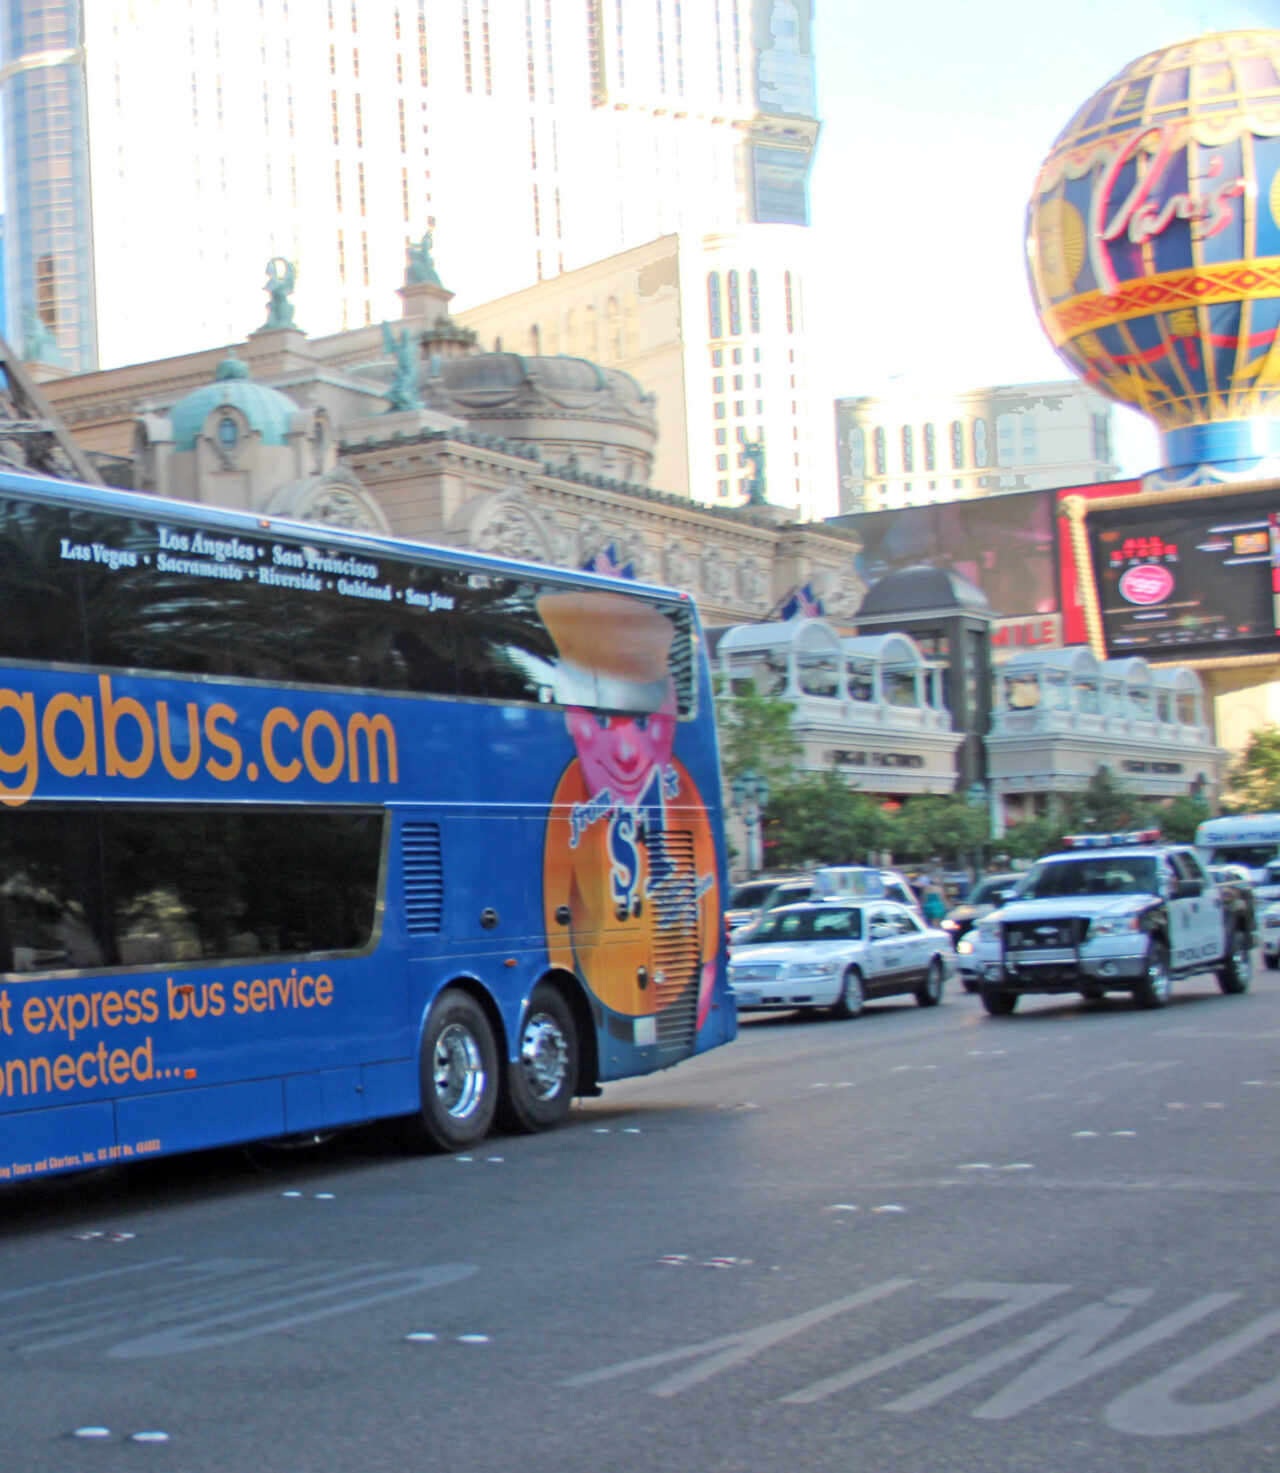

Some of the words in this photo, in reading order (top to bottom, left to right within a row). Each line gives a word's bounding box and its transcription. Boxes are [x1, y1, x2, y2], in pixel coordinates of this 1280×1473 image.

[1089, 123, 1256, 296] Paris
[61, 538, 92, 561] Las
[92, 543, 138, 570] Vegas
[157, 553, 242, 581] Sacramento
[259, 566, 322, 592] Riverside
[337, 578, 392, 602] Oakland
[405, 588, 429, 607] San
[158, 529, 190, 550] Los
[191, 533, 255, 562] Angeles
[272, 545, 304, 568] San
[305, 548, 378, 580] Francisco
[23, 987, 159, 1040] express
[167, 977, 225, 1020] bus
[233, 968, 334, 1014] service
[35, 1159, 48, 1172] and
